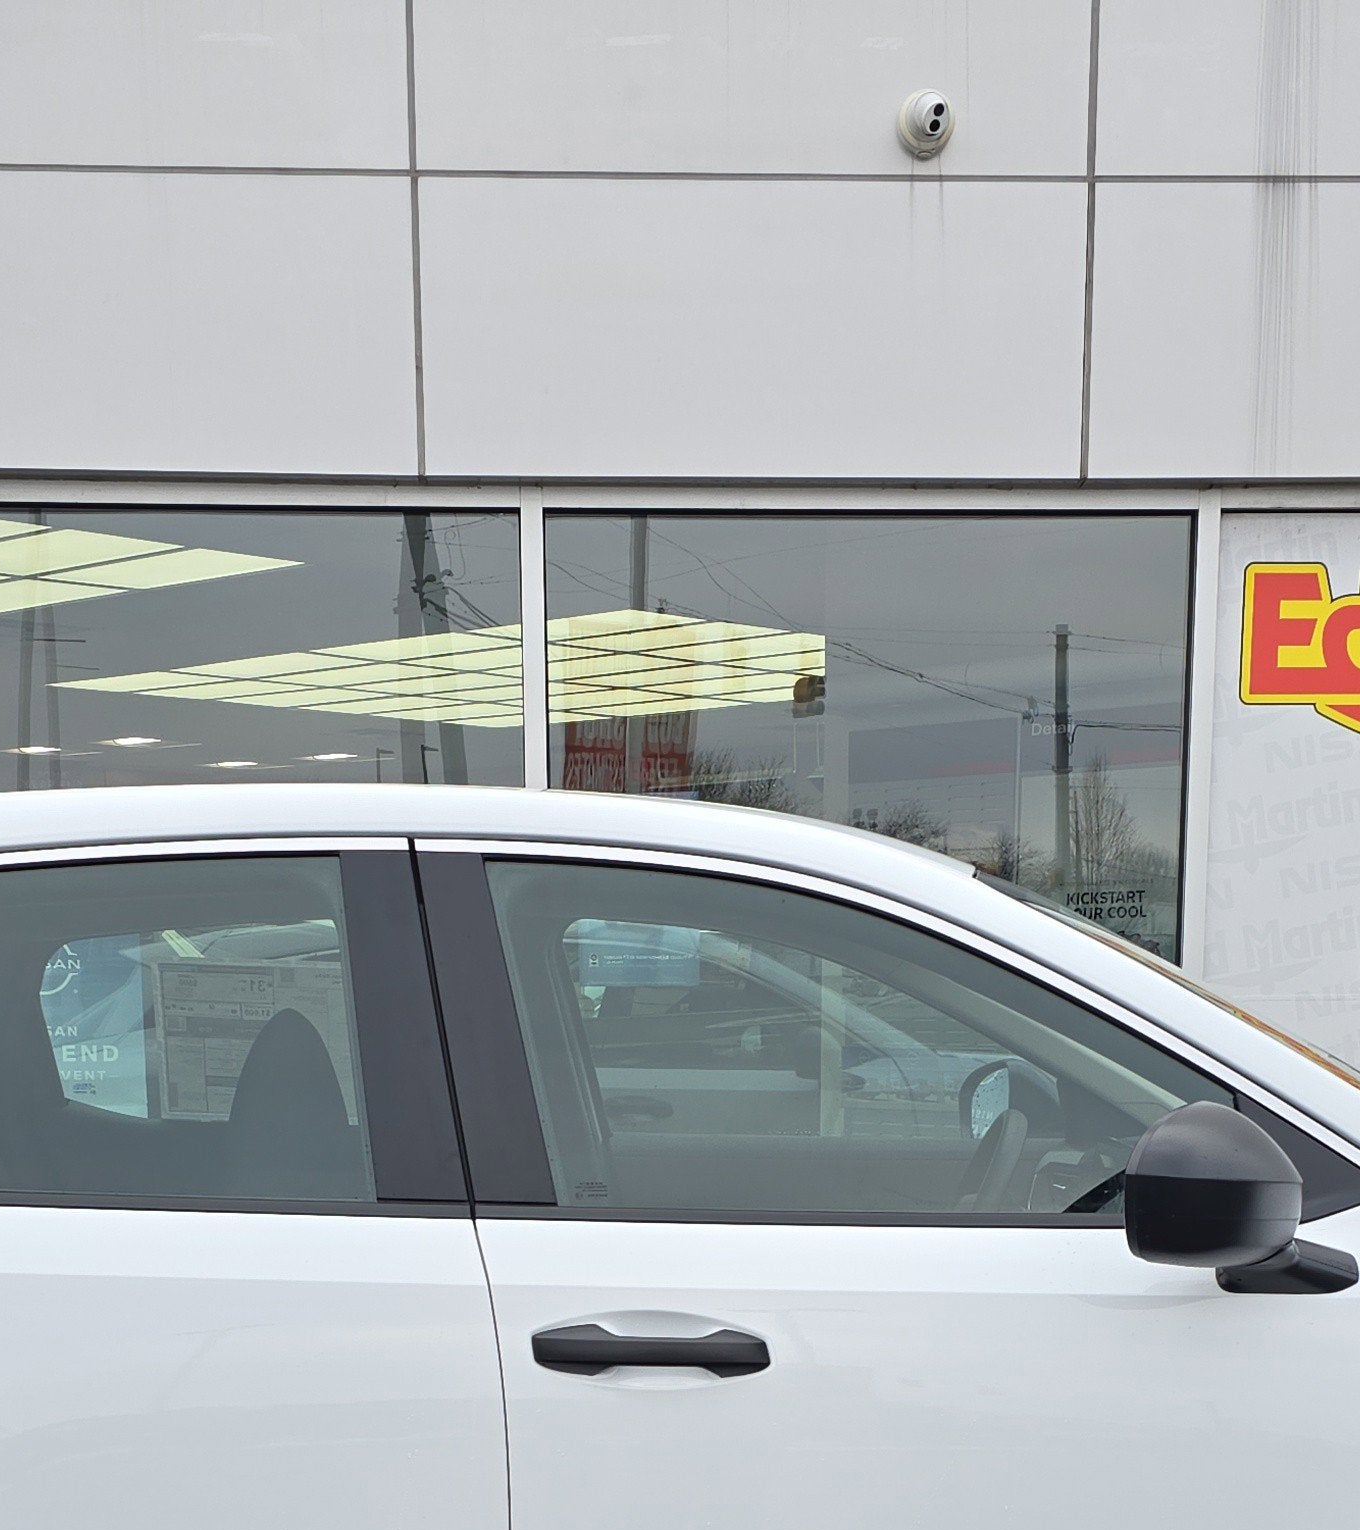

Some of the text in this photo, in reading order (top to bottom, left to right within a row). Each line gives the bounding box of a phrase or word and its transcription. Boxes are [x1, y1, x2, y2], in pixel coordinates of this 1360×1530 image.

[1031, 722, 1076, 737] Detail
[1066, 890, 1147, 906] KICKSTART
[1107, 906, 1150, 920] COOL
[61, 1044, 119, 1063] END
